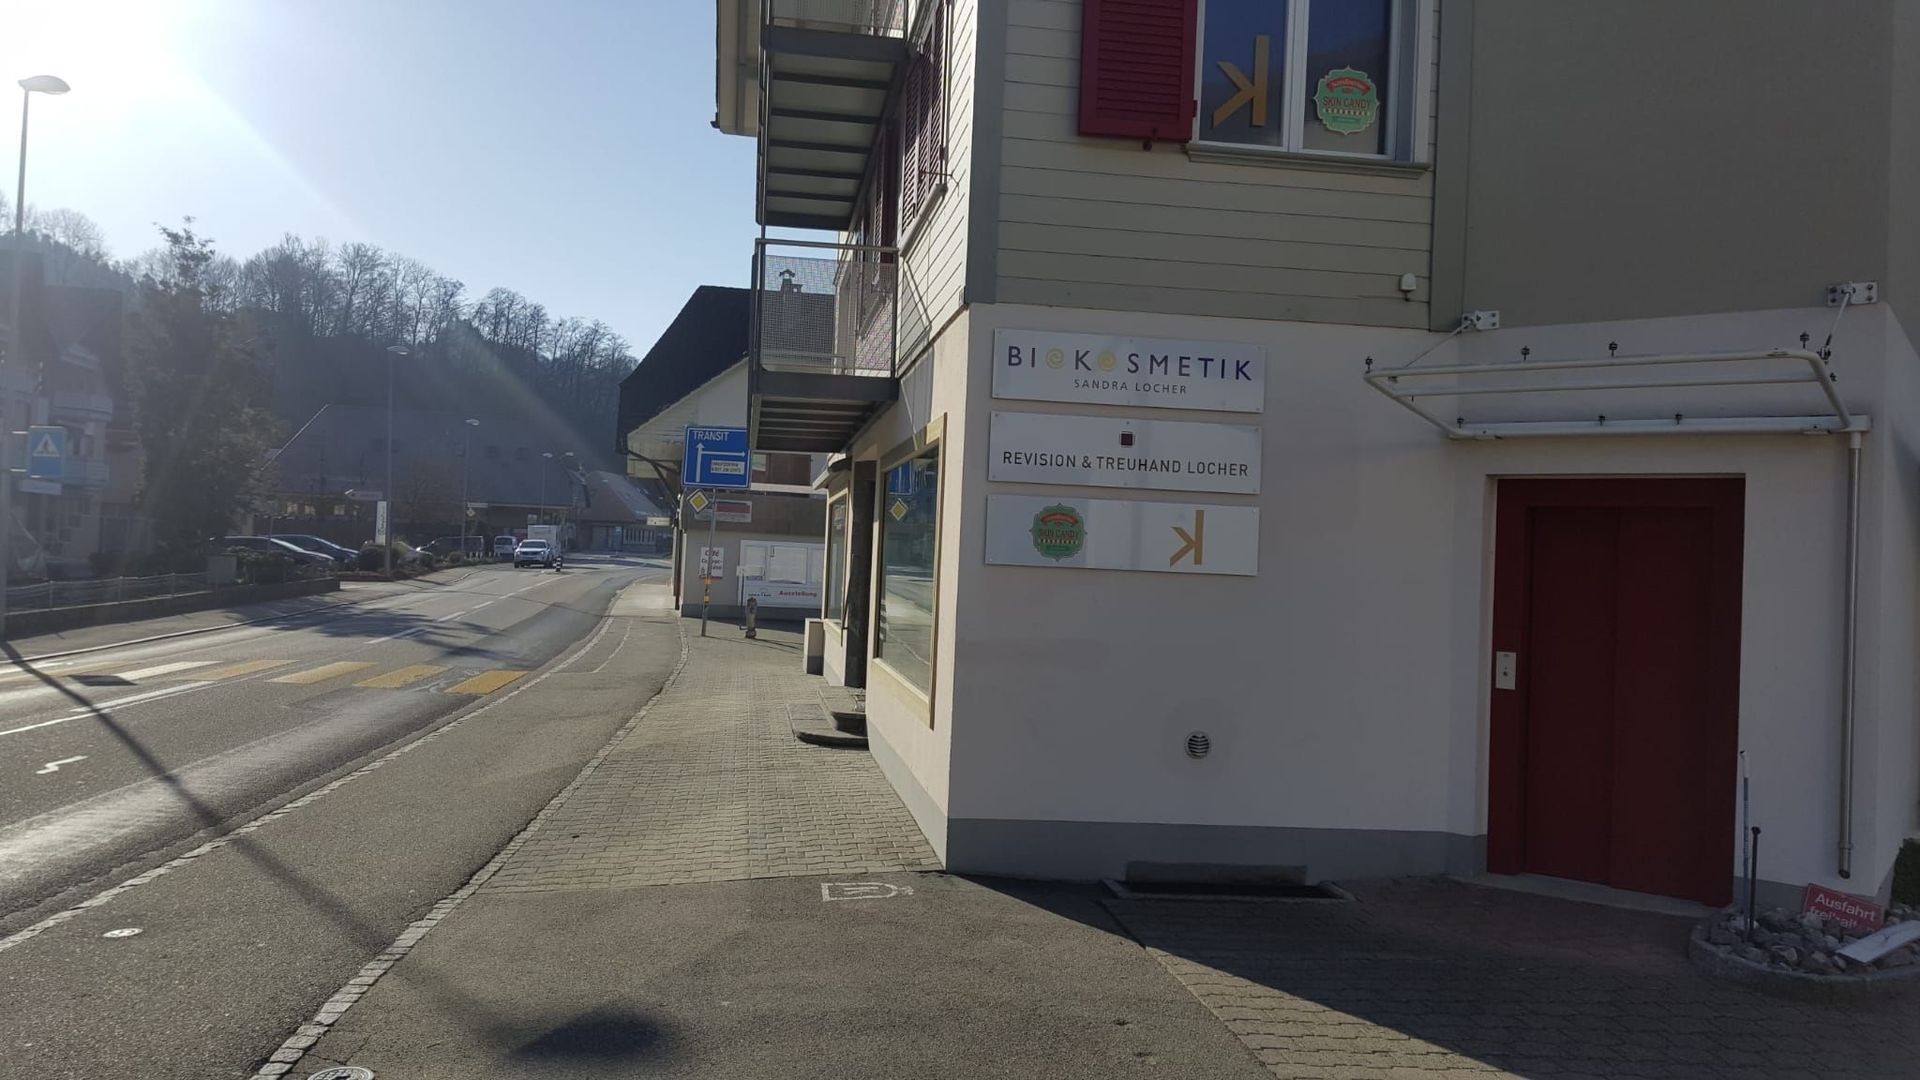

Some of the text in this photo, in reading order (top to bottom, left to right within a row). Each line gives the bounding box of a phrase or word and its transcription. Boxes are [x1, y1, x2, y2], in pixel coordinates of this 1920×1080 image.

[1323, 95, 1341, 107] SKIN
[1074, 378, 1187, 395] SANDRA LOCHER
[692, 430, 730, 441] TRANSIT
[1003, 451, 1249, 477] REVISION & TREUHAND LOCHER
[1815, 893, 1875, 922] Ausfahrt
